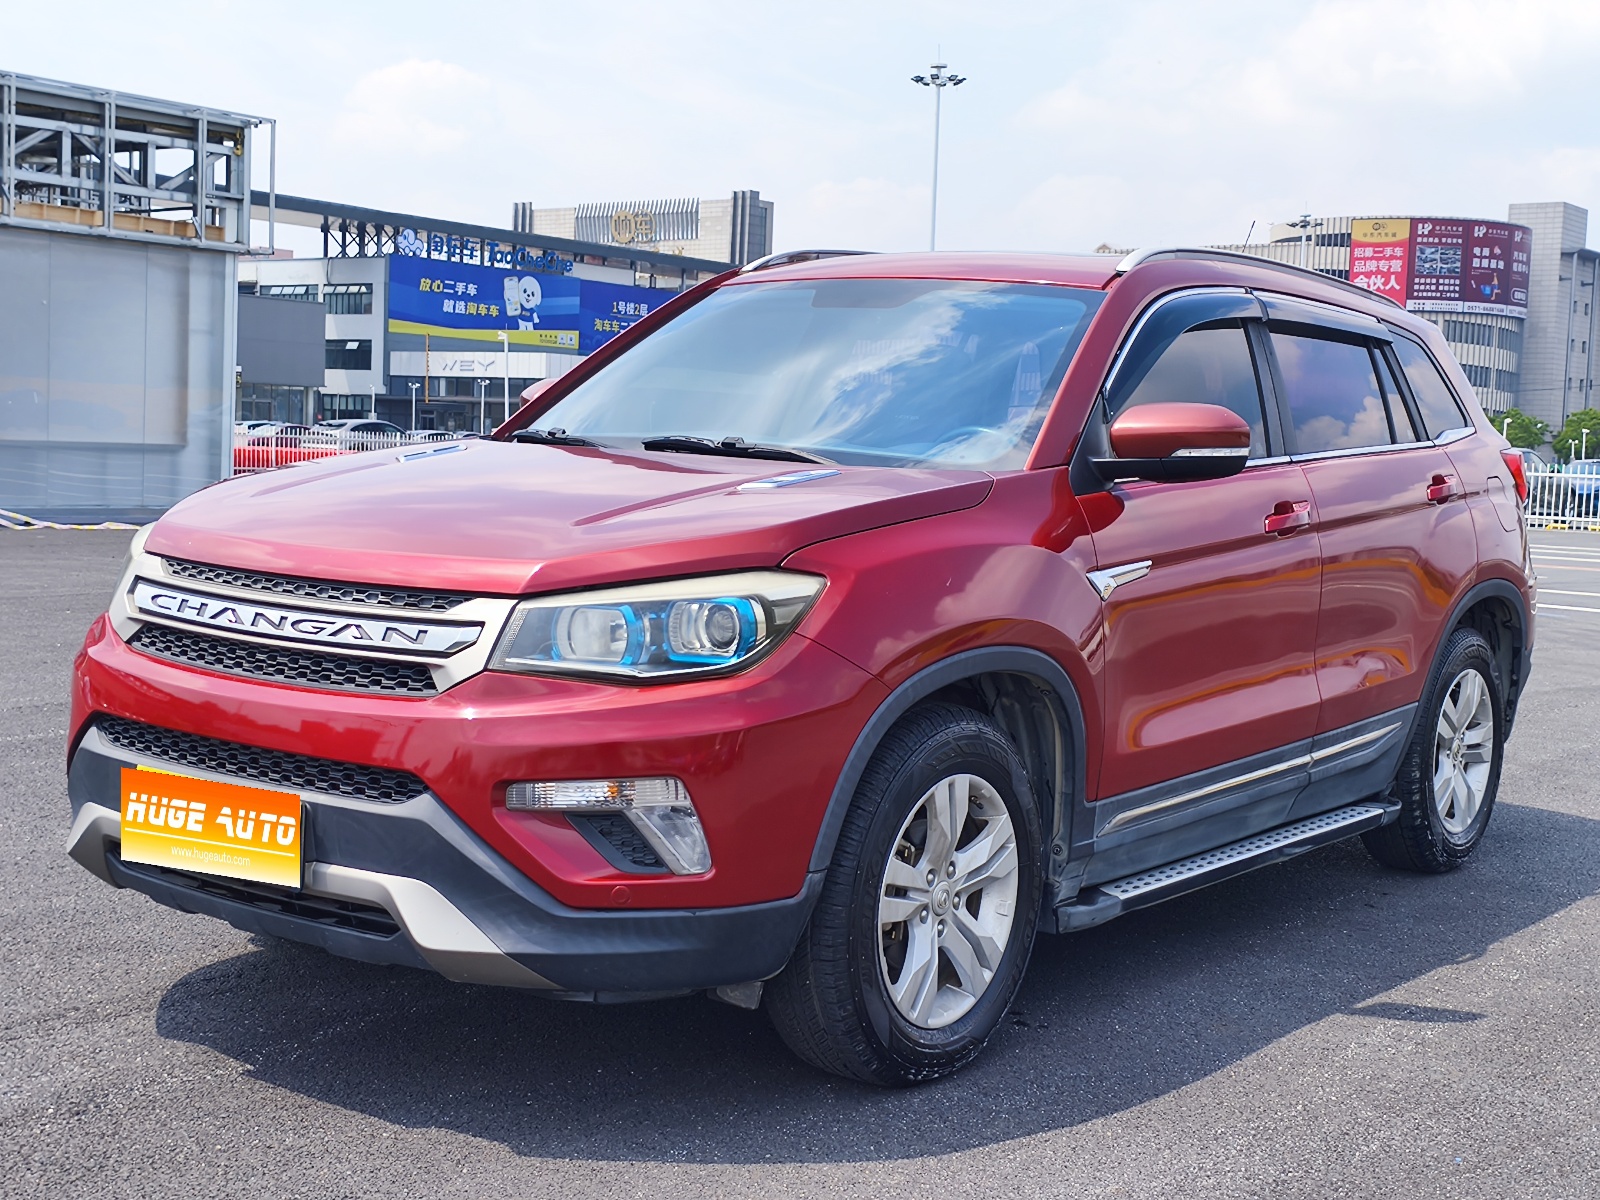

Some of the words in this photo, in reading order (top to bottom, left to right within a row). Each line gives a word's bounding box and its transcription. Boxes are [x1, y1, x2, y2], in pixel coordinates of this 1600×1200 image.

[486, 241, 574, 273] TaoCheChe
[1354, 246, 1404, 258] 招募二手车
[1354, 260, 1403, 273] 品牌专营
[419, 277, 479, 297] 放心二手车
[1354, 274, 1401, 291] 合伙人
[443, 299, 500, 318] 就选淘车车
[612, 301, 648, 316] 1号楼2层
[594, 318, 634, 333] 淘车车二
[441, 359, 495, 372] WEY
[151, 593, 428, 645] CHANGAN
